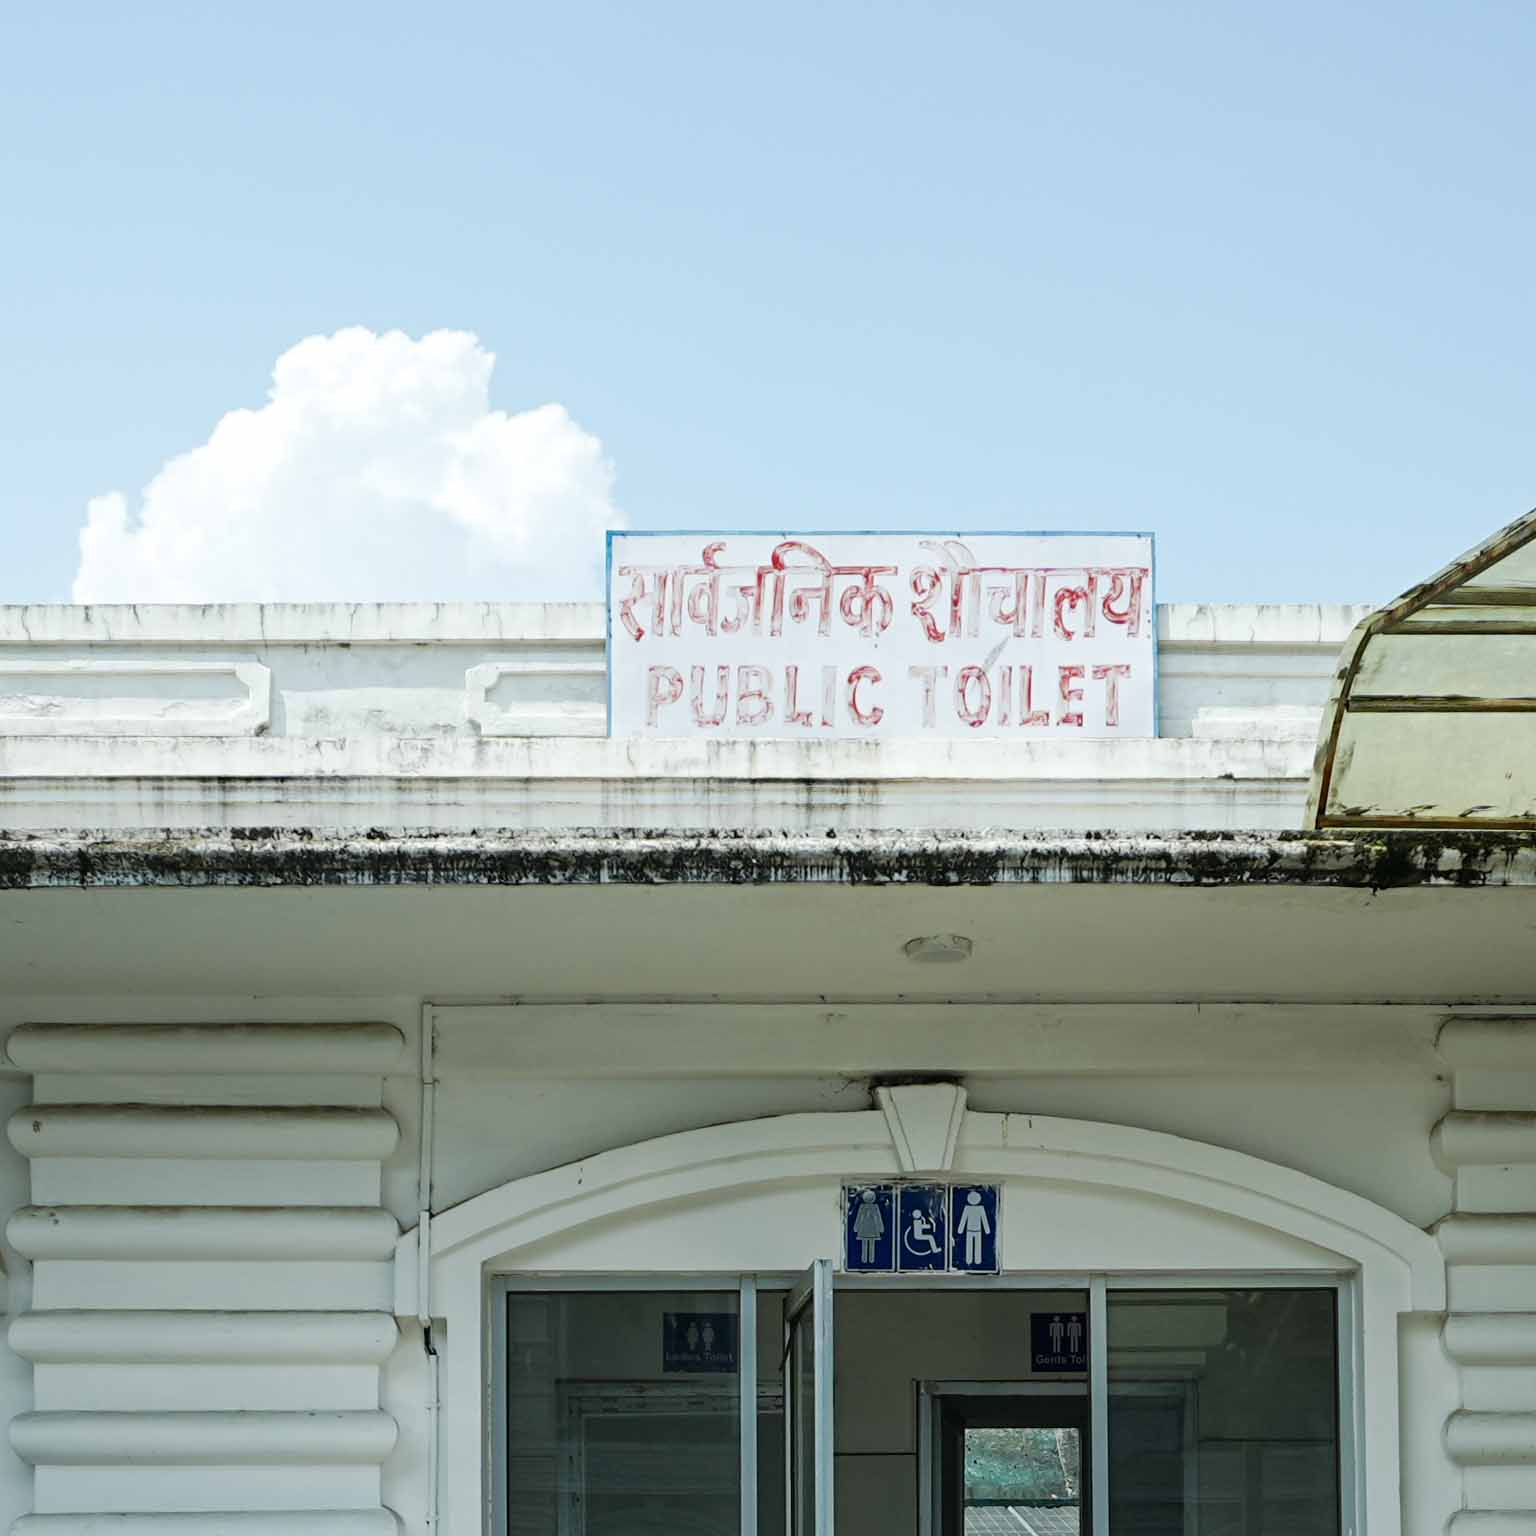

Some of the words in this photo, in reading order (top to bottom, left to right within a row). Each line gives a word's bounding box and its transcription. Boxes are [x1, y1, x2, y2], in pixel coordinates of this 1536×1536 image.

[618, 541, 898, 641] सार्वजनिक
[646, 665, 884, 728] PUBLIC
[908, 664, 1131, 728] TOILET
